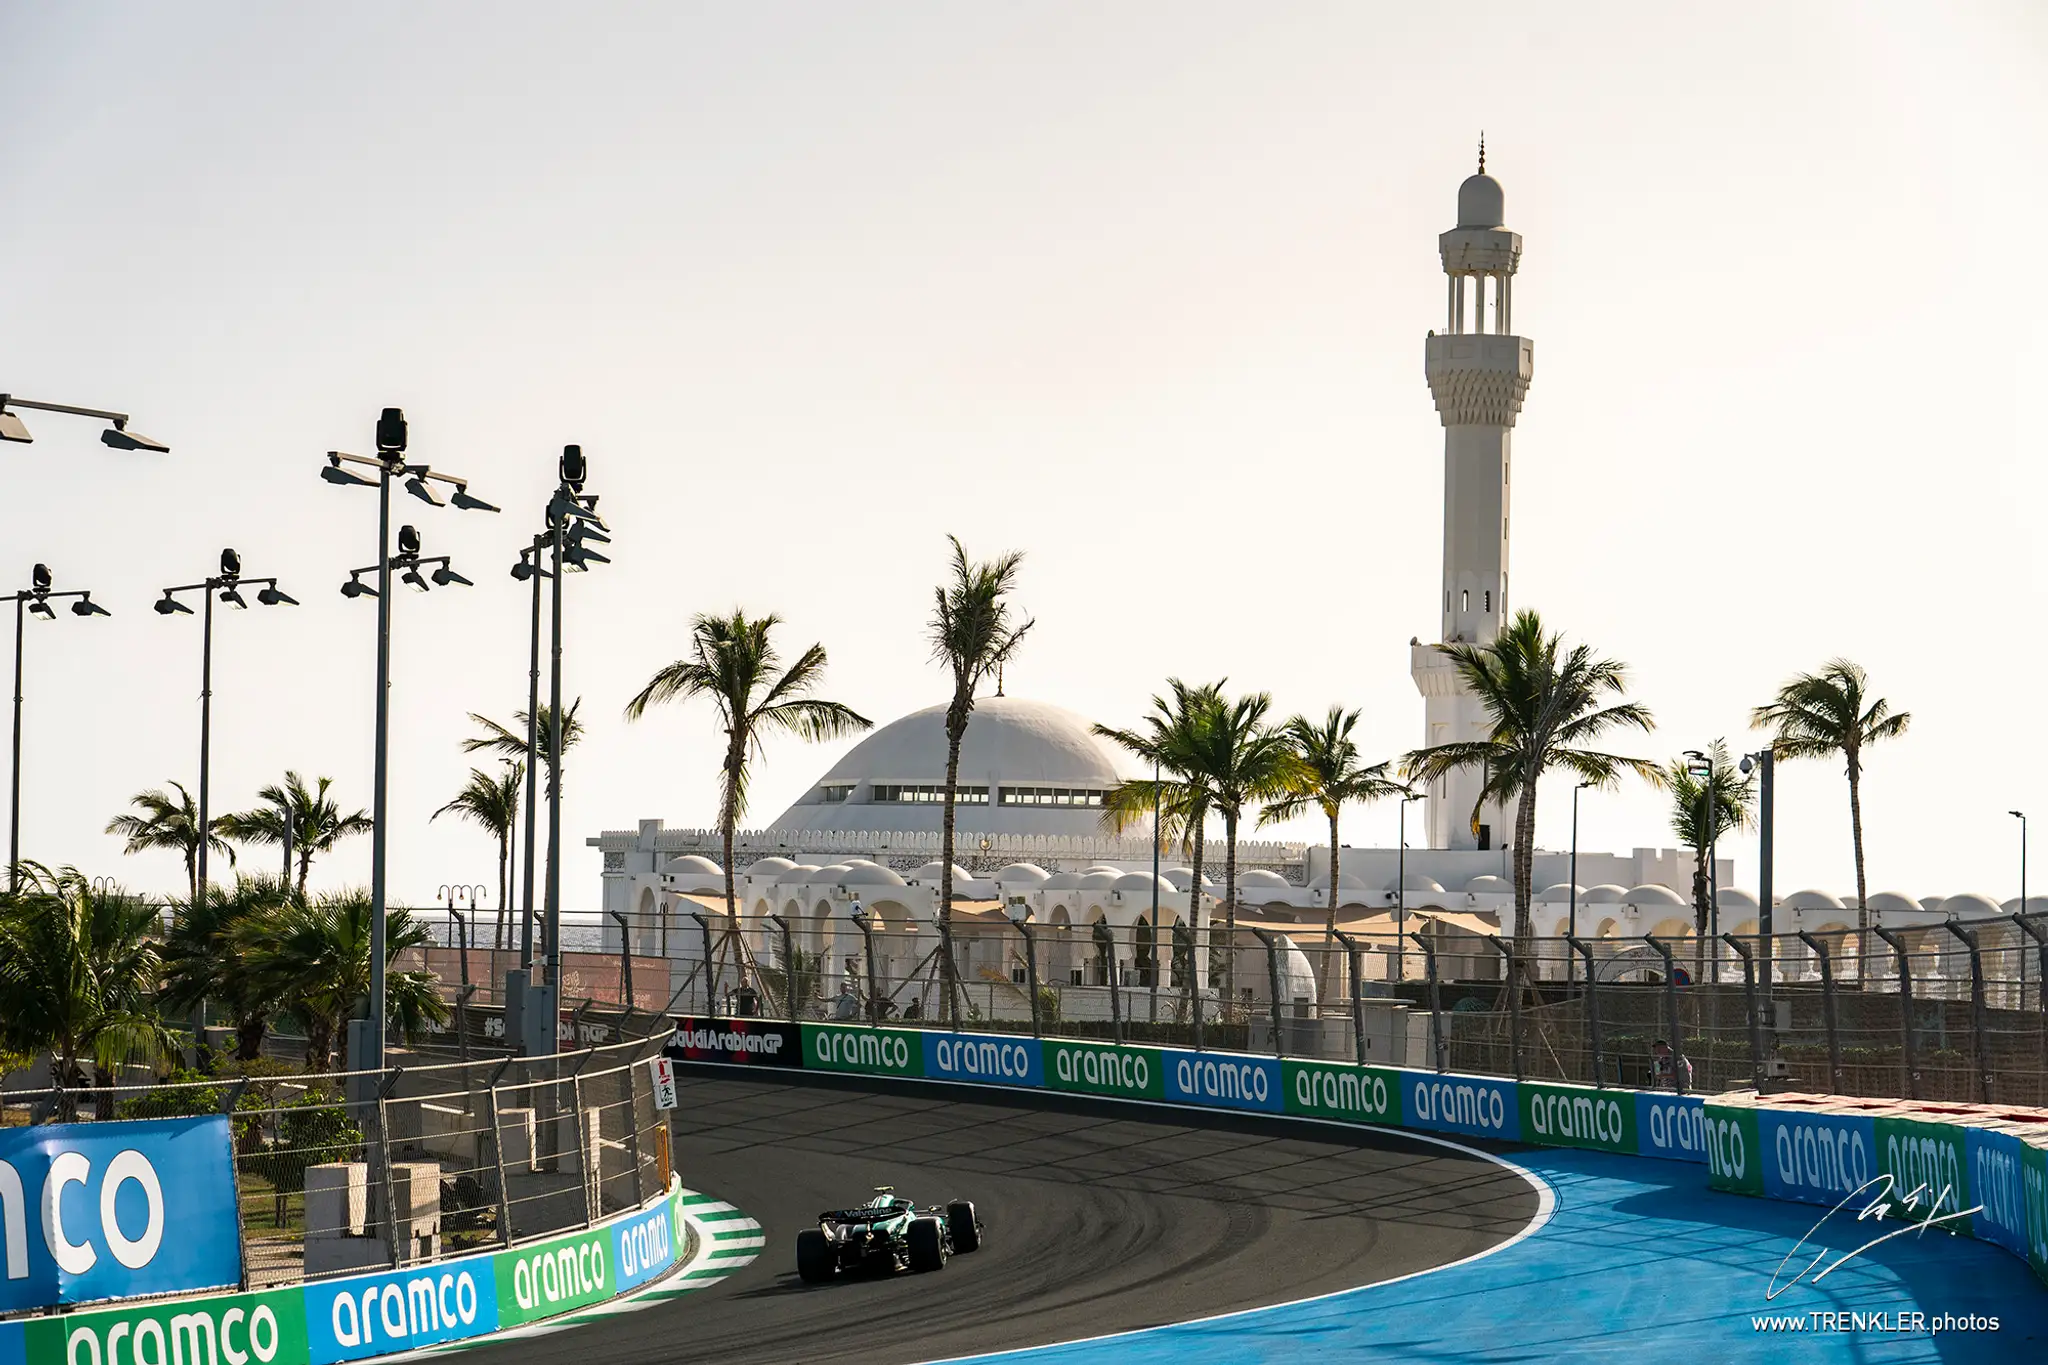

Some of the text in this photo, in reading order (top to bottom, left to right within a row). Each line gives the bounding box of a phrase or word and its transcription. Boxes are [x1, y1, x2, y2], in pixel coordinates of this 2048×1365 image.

[816, 1031, 909, 1068] aramco
[937, 1039, 1028, 1078] aramco
[1056, 1048, 1148, 1090] aramco
[1177, 1059, 1268, 1102] aramco
[1296, 1069, 1387, 1115] aramco
[1415, 1081, 1504, 1129] aramco
[1531, 1093, 1622, 1143] aramco
[1650, 1104, 1705, 1151] aram
[1776, 1124, 1868, 1195] aramco
[1888, 1134, 1960, 1213] aramco
[844, 1208, 892, 1217] Valvoline
[621, 1212, 669, 1277] aramco
[514, 1240, 605, 1310] aramco
[332, 1271, 477, 1348] aramco
[66, 1304, 279, 1365] aramco
